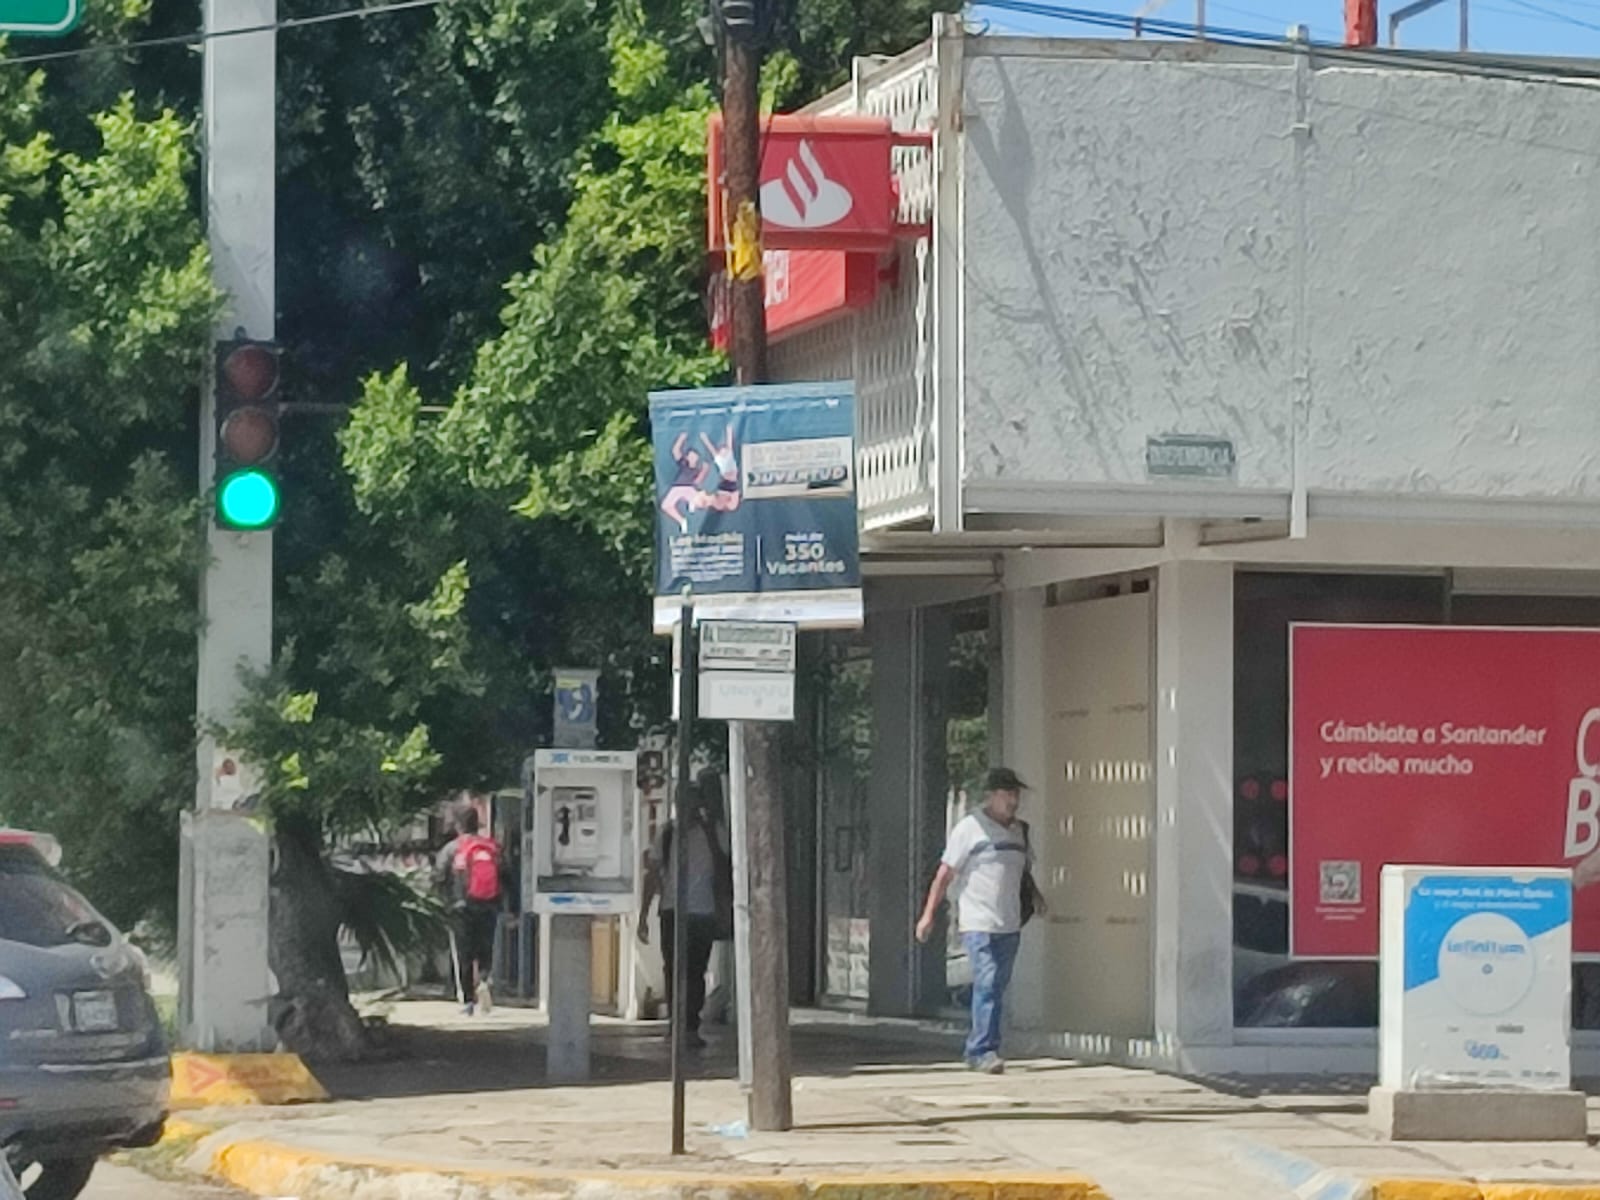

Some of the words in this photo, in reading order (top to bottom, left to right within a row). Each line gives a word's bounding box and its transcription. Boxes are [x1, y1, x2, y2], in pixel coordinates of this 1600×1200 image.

[785, 543, 824, 561] 350
[766, 560, 845, 575] Vacantes
[1320, 720, 1418, 744] Cámbiate
[1422, 727, 1436, 744] a
[1440, 722, 1547, 745] Santander
[1320, 757, 1333, 779] y
[1337, 753, 1400, 775] recibe
[1404, 754, 1473, 775] mucho
